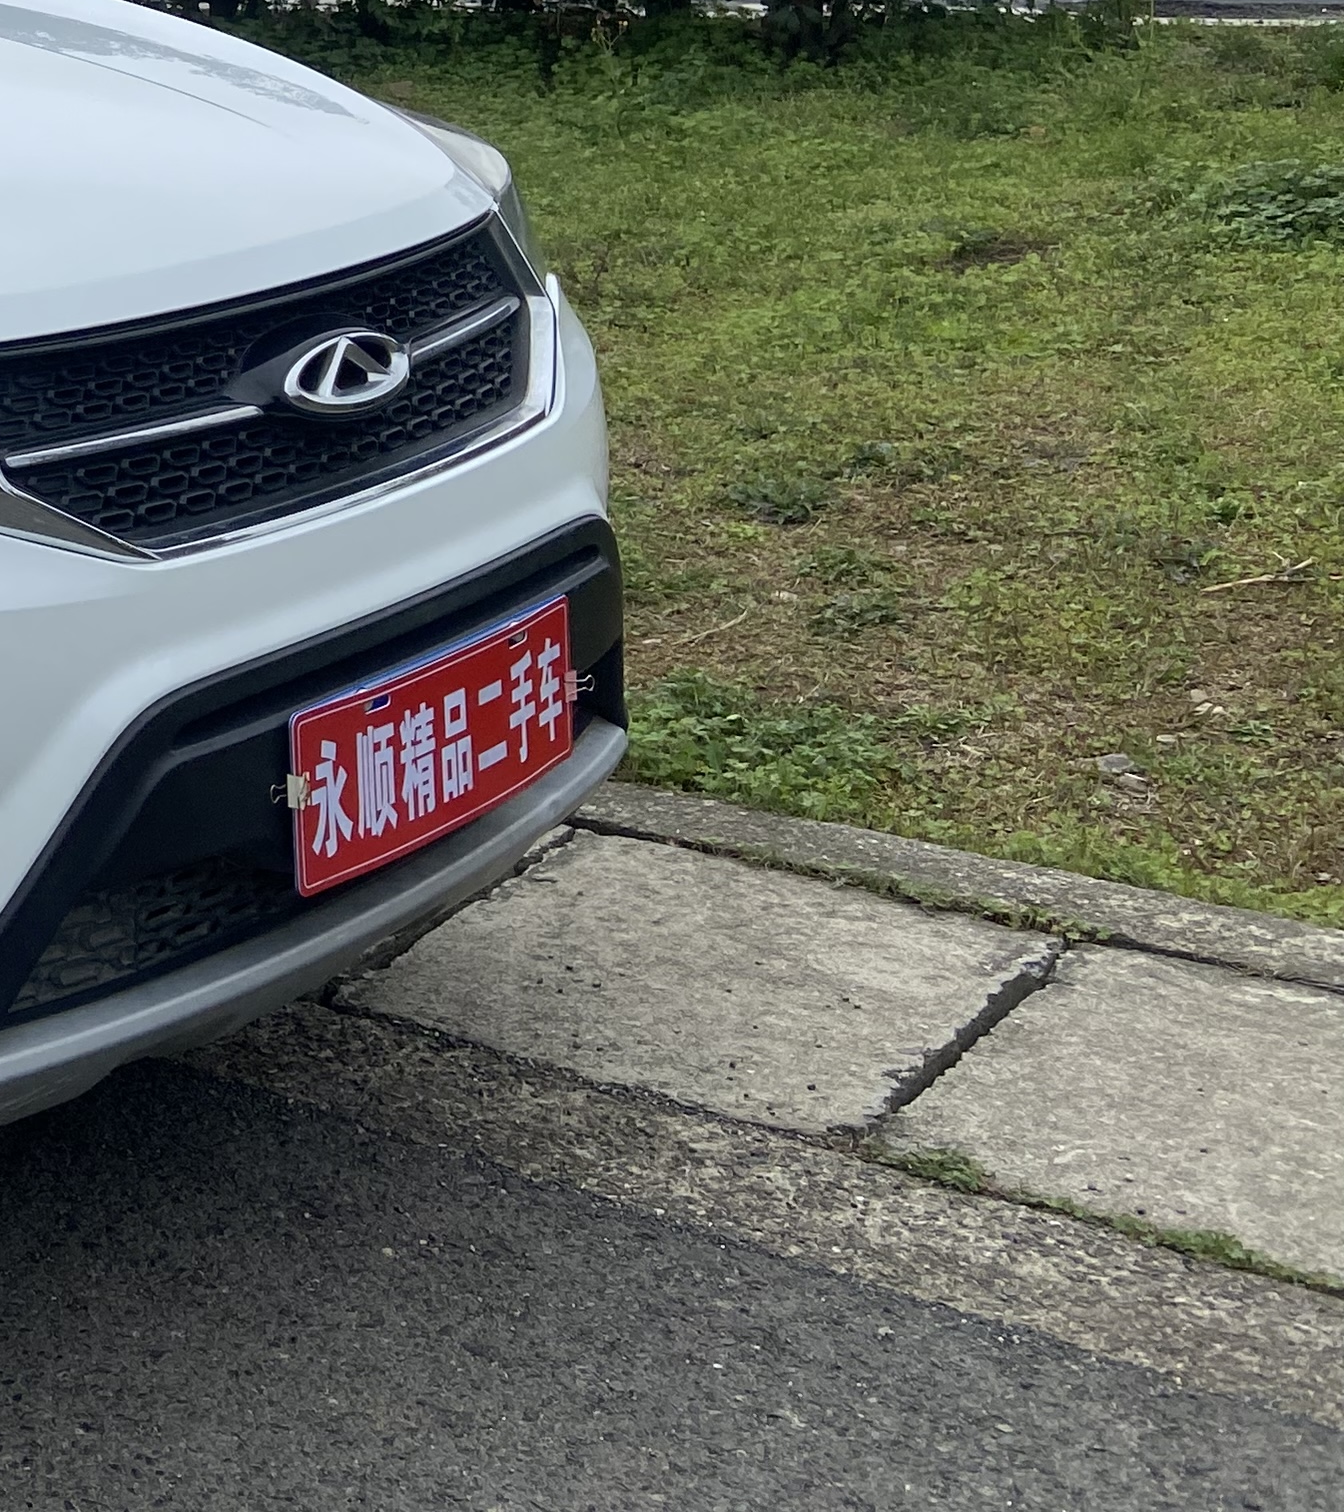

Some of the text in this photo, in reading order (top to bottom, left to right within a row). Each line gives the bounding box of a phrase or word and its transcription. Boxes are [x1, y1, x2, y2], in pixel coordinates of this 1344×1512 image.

[312, 638, 563, 858] 永顺精品二手车
